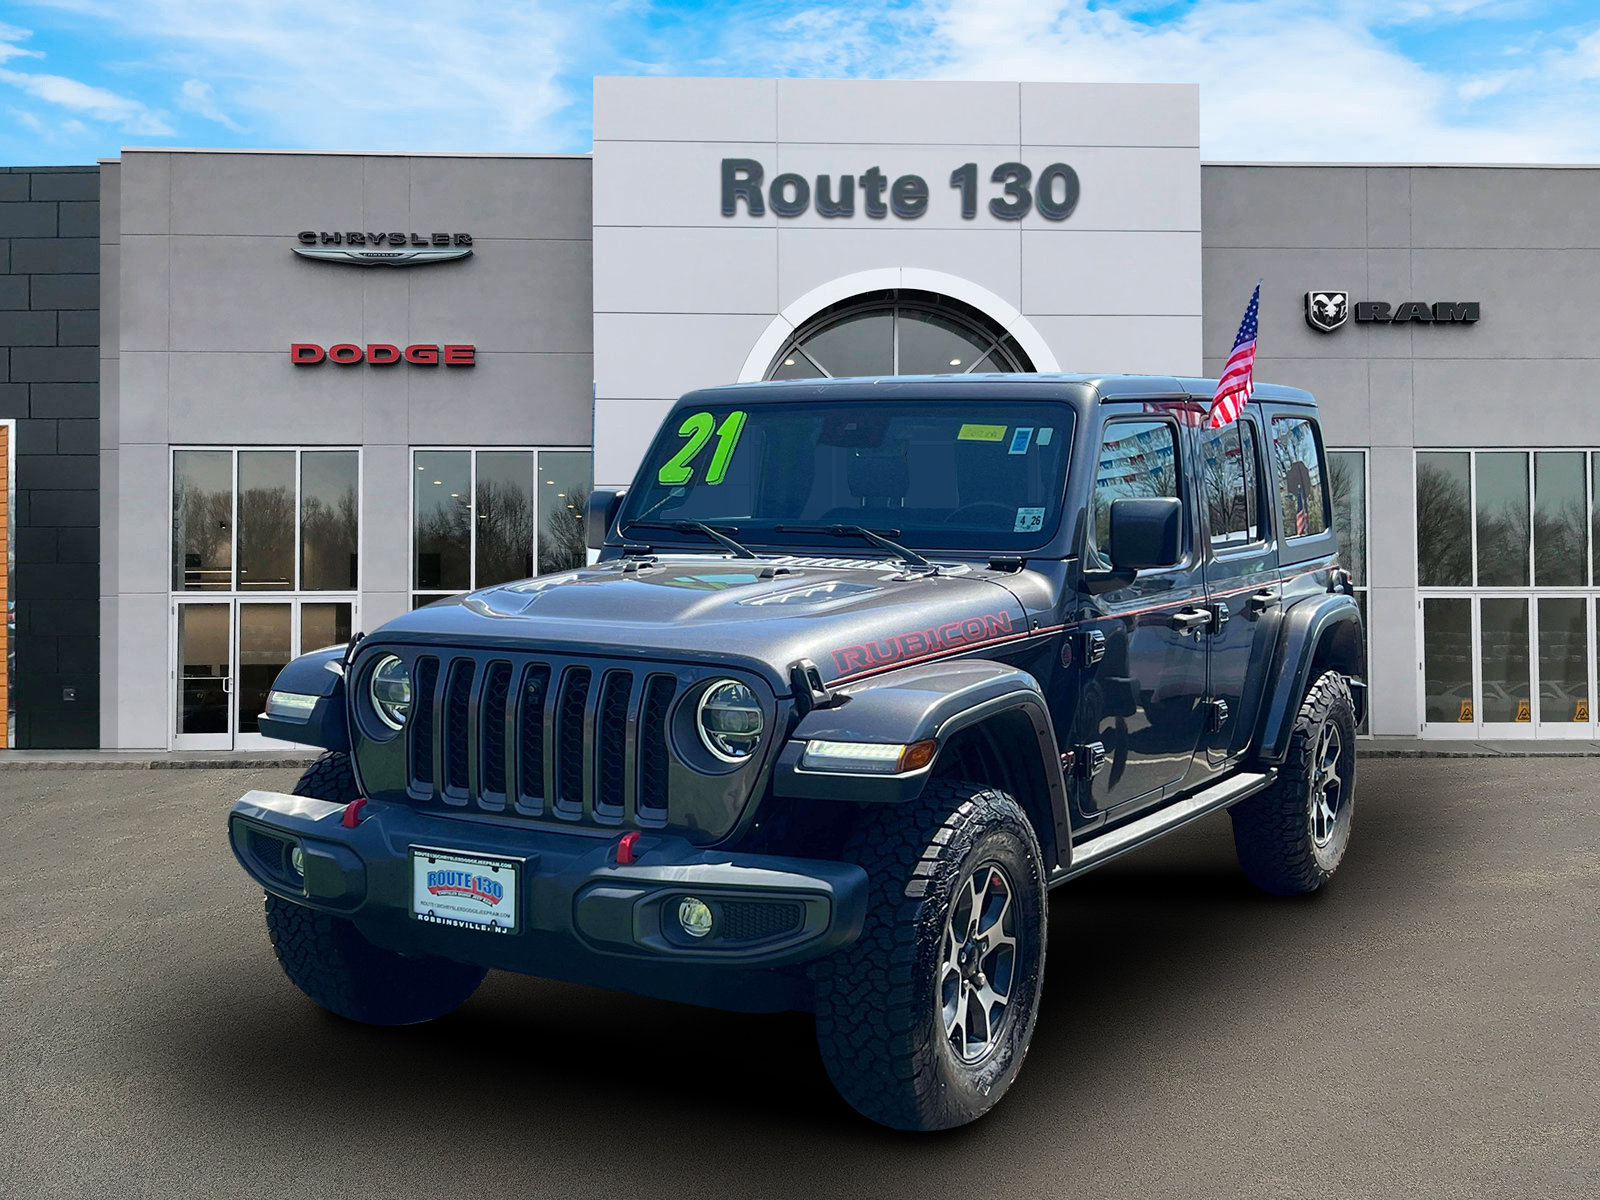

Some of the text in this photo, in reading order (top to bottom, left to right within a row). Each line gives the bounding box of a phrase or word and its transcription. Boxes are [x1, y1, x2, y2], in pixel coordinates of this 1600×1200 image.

[721, 158, 1080, 219] Route 130
[298, 231, 473, 246] CHRYSLER
[1355, 302, 1480, 323] RAM
[291, 343, 476, 366] DODGE
[658, 410, 748, 486] 21
[1020, 515, 1041, 526] 4 26
[831, 611, 1013, 674] RUBICON
[427, 870, 473, 888] ROUTE
[474, 875, 503, 899] 130
[417, 914, 508, 934] ROBBINSVILLE, NJ
